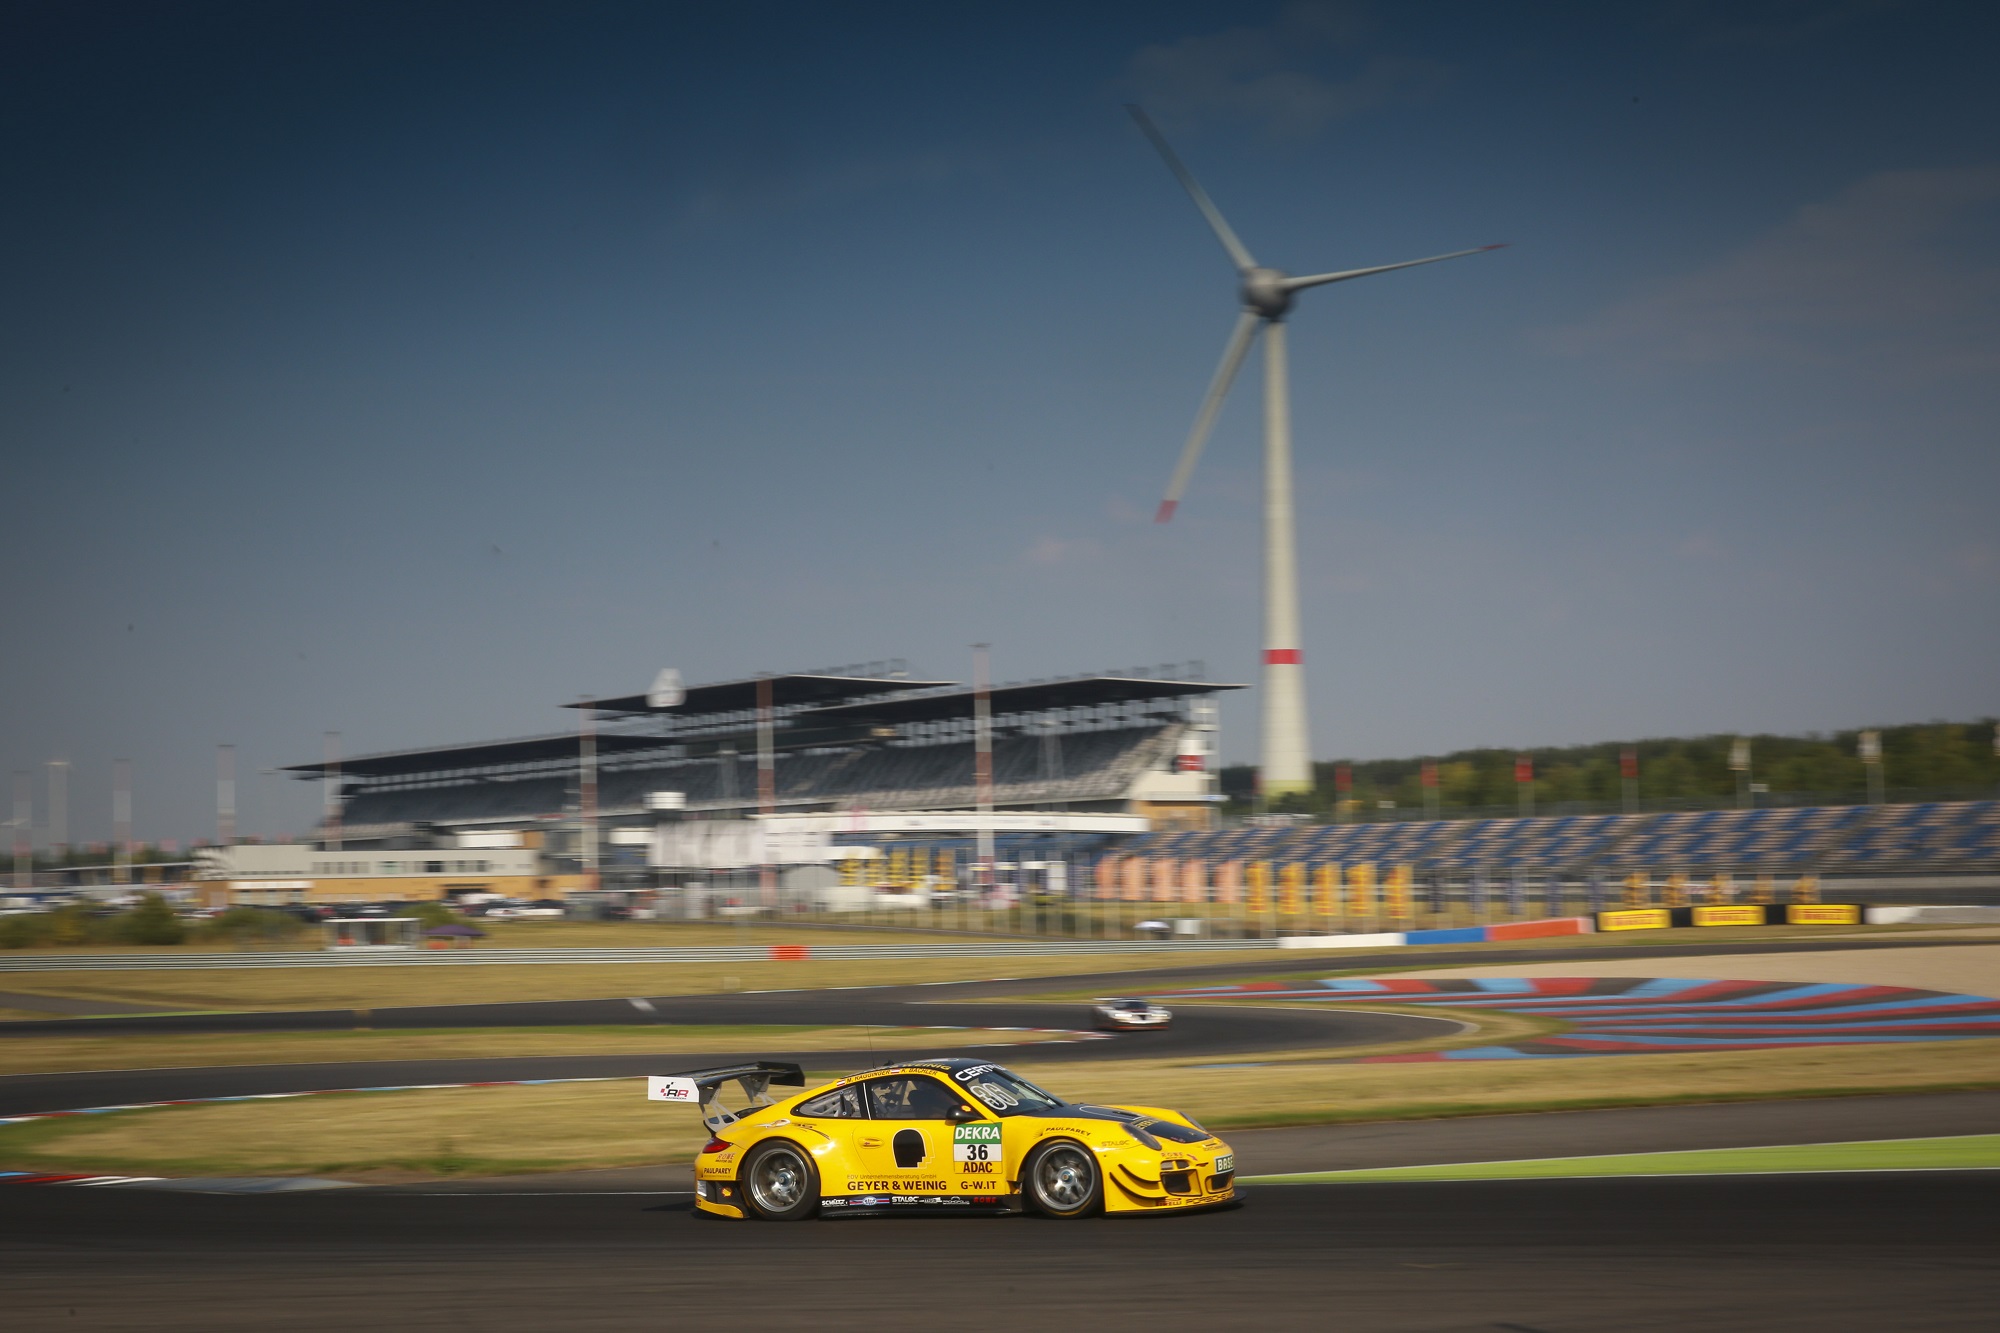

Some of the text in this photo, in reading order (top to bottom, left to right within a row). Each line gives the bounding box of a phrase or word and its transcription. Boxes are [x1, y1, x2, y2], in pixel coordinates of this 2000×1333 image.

[667, 1089, 689, 1097] RR
[970, 1083, 1019, 1110] 36
[955, 1126, 1001, 1139] DEKRA
[967, 1144, 988, 1160] 36
[703, 1167, 731, 1175] PAULPAREY
[963, 1161, 993, 1173] ADAC
[847, 1180, 947, 1191] GEYER & WEINIG
[961, 1181, 996, 1190] G-W.IT
